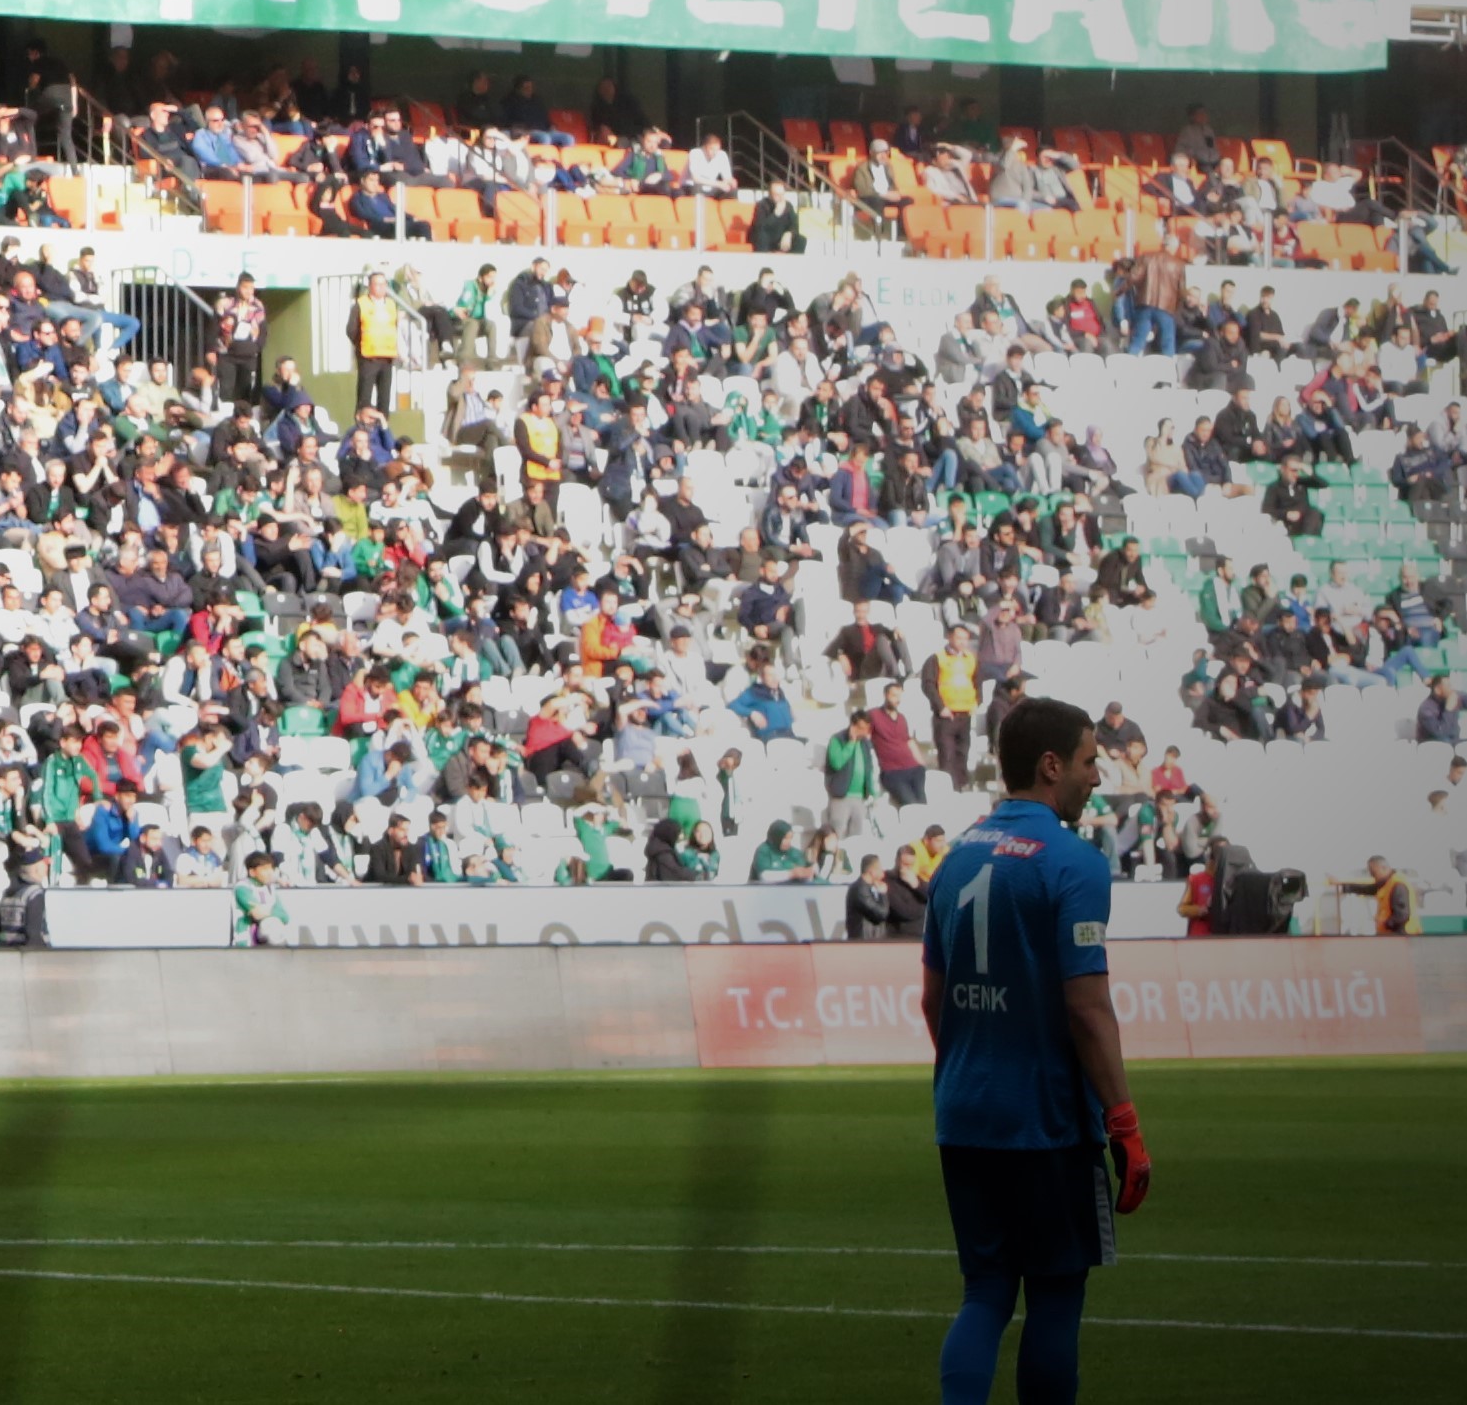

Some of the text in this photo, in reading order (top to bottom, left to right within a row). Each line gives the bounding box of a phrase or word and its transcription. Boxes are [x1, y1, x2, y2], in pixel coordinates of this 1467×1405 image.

[877, 276, 892, 305] E
[957, 863, 994, 975] 1
[726, 986, 803, 1030] T.C.
[1176, 970, 1387, 1024] BAKANLIĞI
[952, 983, 1008, 1013] CENK
